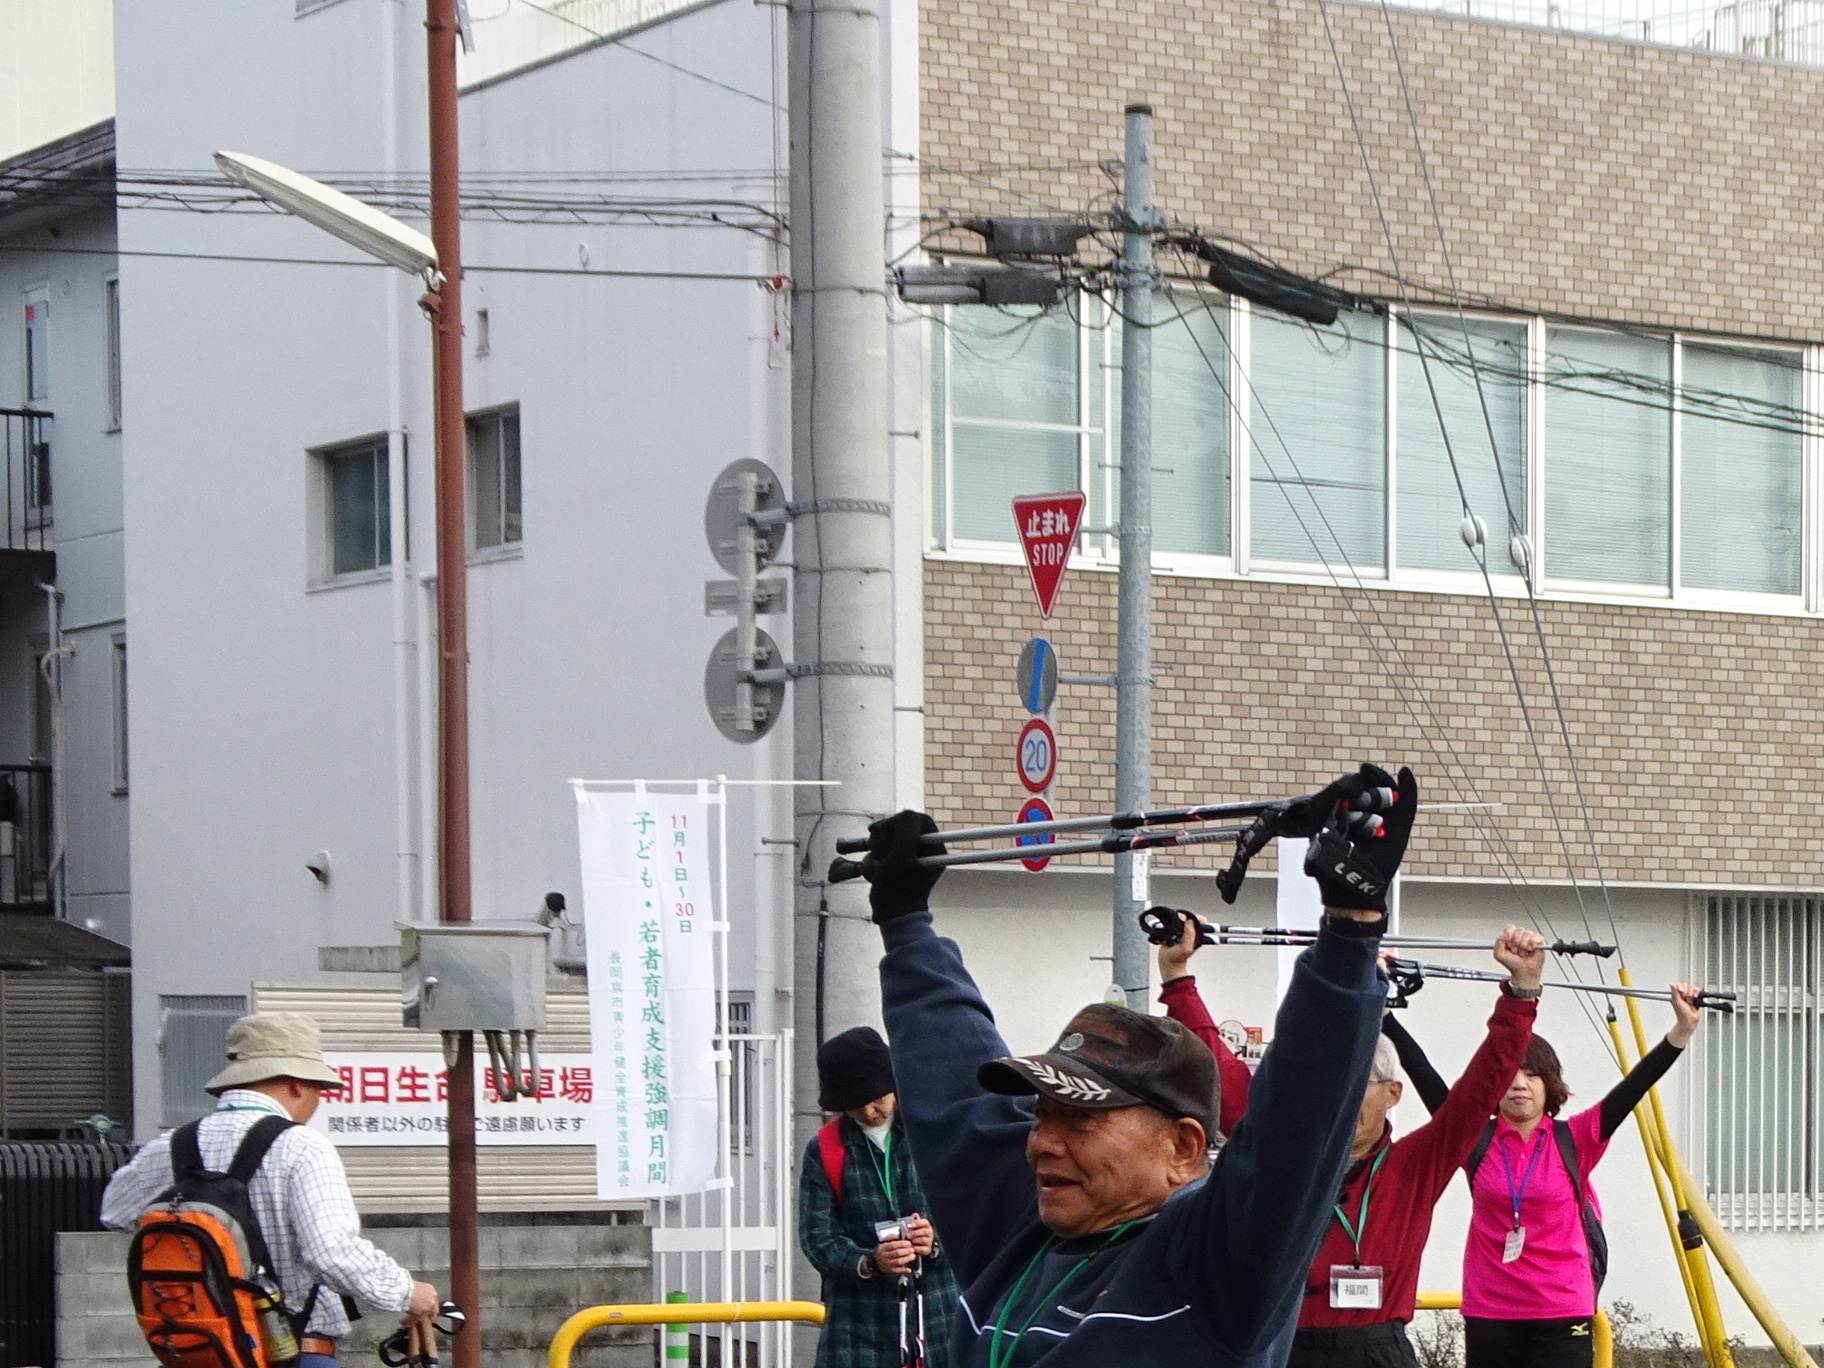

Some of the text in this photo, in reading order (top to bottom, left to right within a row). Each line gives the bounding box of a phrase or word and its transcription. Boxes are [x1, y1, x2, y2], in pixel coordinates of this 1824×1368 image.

[1025, 507, 1071, 538] 止まれ
[1032, 541, 1064, 566] STOP
[1025, 739, 1047, 772] 20
[631, 811, 669, 1186] 子ども・若者育成支援強調月間
